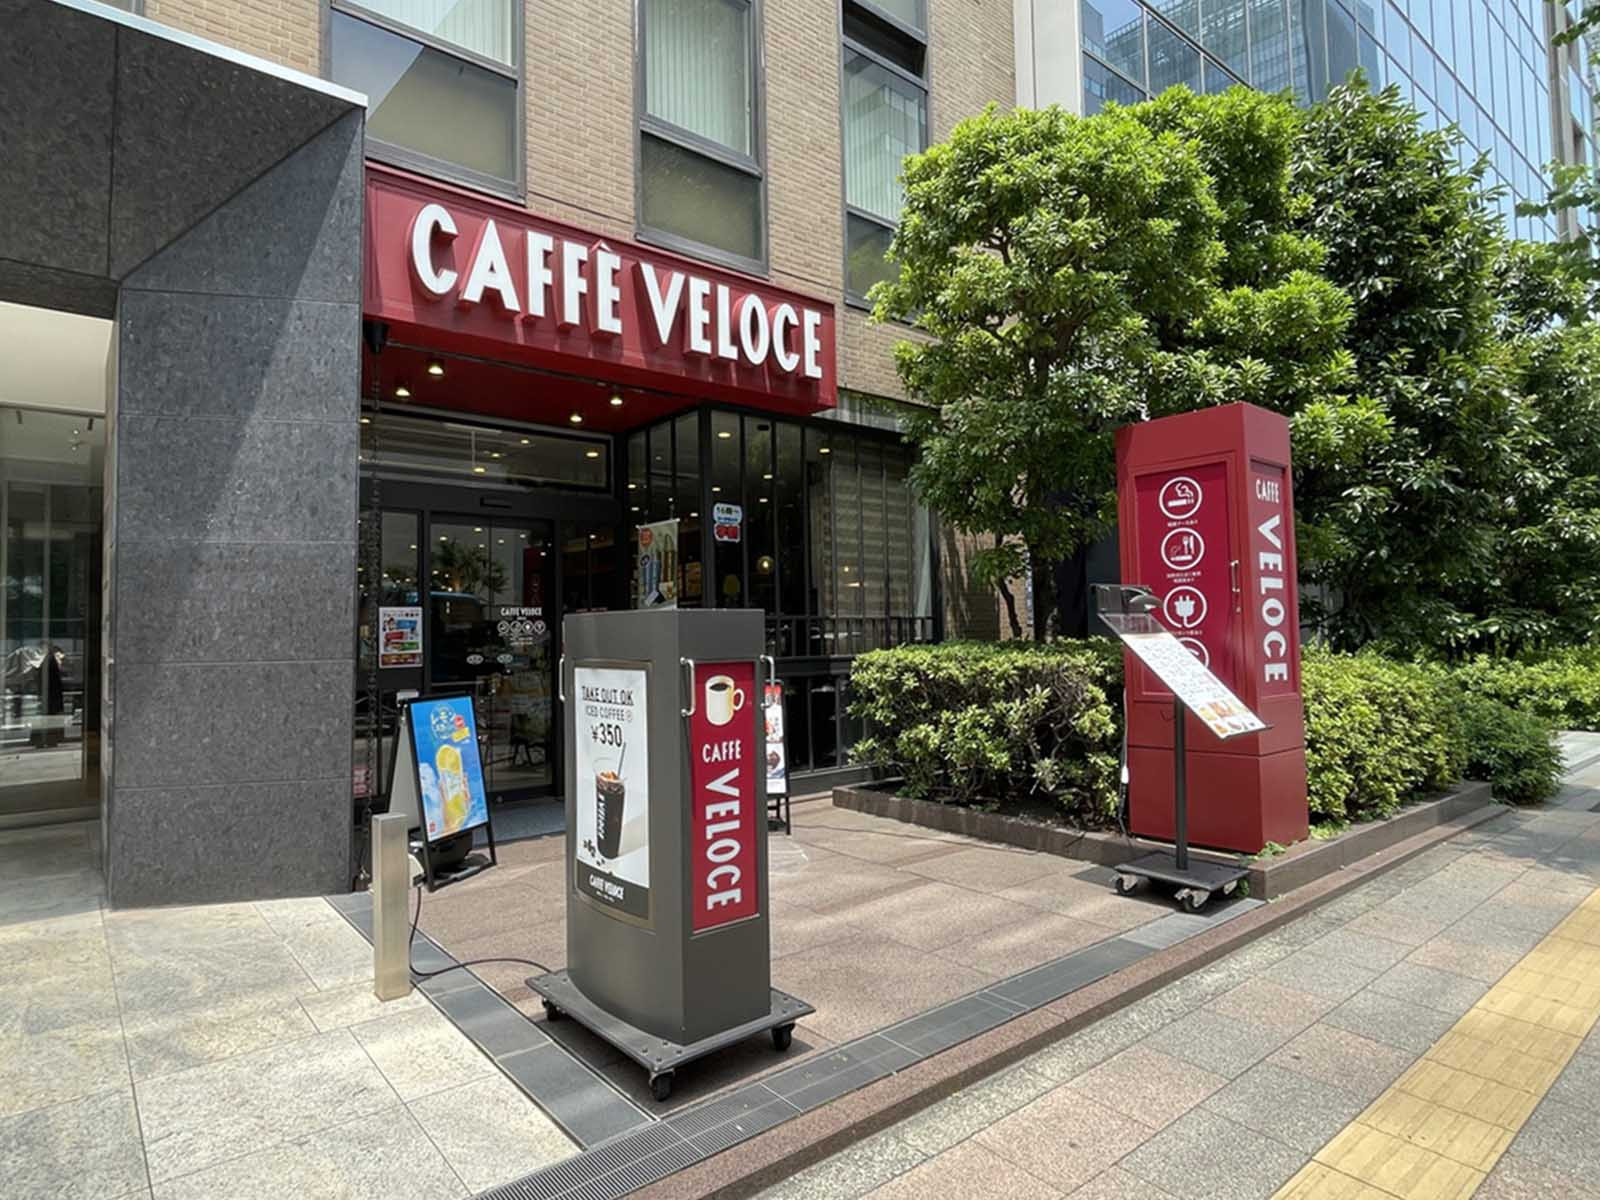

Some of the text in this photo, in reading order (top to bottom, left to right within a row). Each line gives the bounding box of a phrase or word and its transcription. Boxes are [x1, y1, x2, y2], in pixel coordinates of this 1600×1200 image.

[639, 262, 823, 379] VELOCE
[1257, 514, 1288, 683] VELOCE
[582, 685, 634, 705] TAKE OUT OK
[600, 706, 625, 721] COFFEE
[591, 722, 622, 747] ¥350
[705, 767, 742, 911] VELOCE
